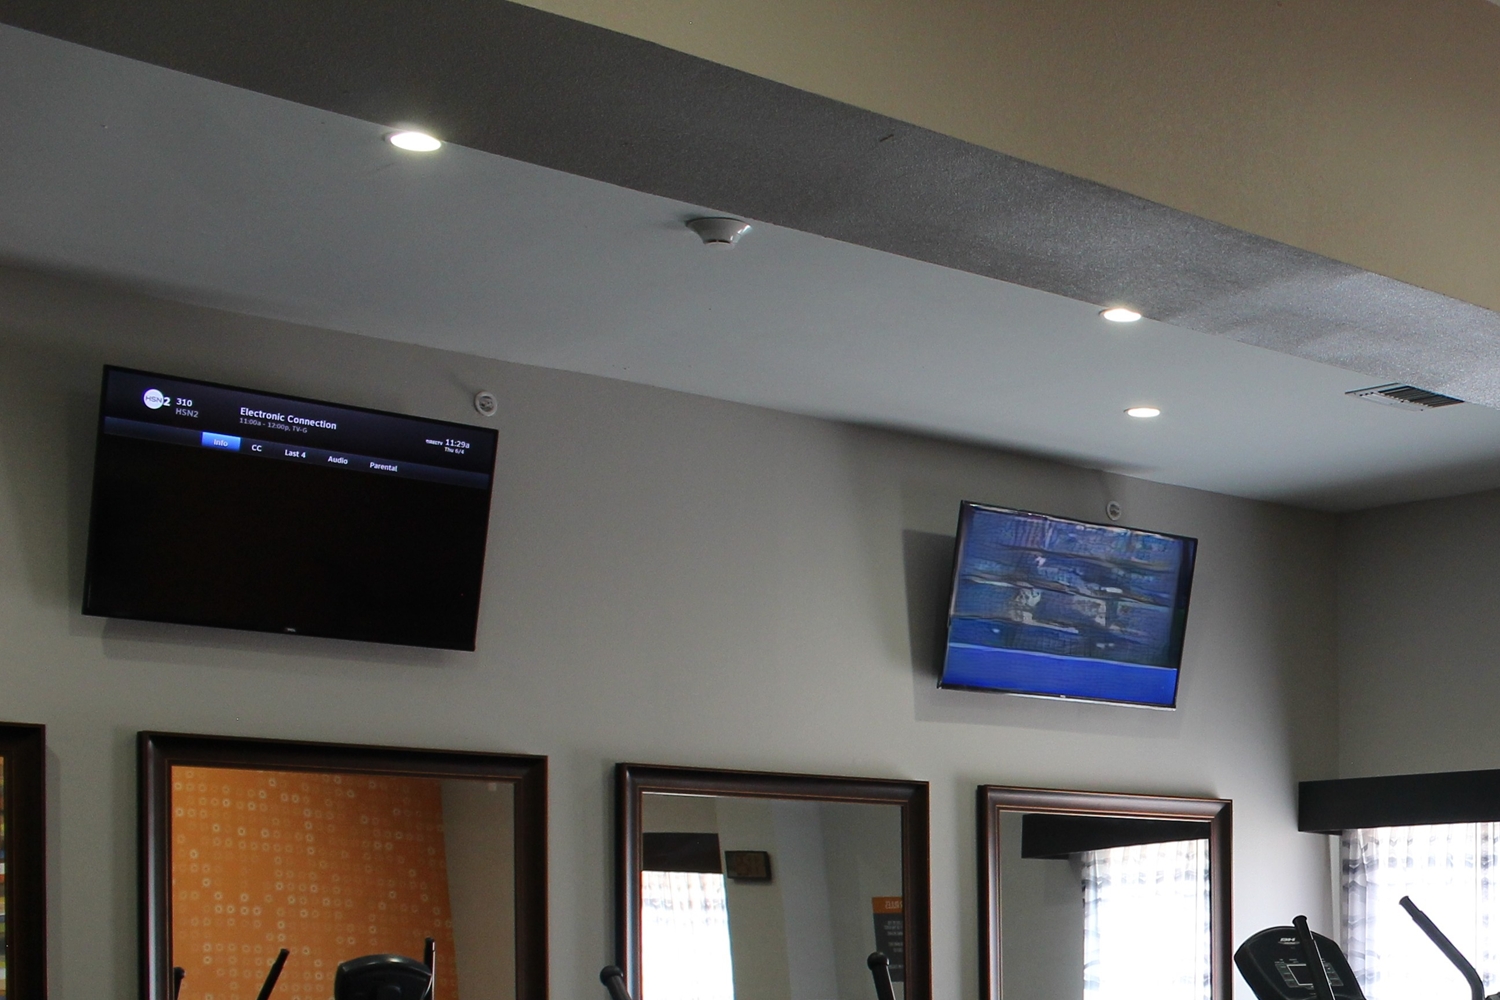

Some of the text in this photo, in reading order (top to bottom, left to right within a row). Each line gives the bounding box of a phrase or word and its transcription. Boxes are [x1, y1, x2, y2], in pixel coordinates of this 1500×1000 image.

[176, 397, 193, 407] 310
[175, 408, 199, 418] HSN2
[240, 407, 337, 430] Electronic Connection
[239, 417, 262, 427] 11:00a
[292, 425, 308, 434] TV-G
[213, 439, 228, 447] Info
[445, 438, 470, 449] 11:29a
[285, 449, 299, 457] Last
[444, 446, 454, 454] Thu
[327, 456, 348, 464] Audio
[370, 462, 398, 472] Parental
